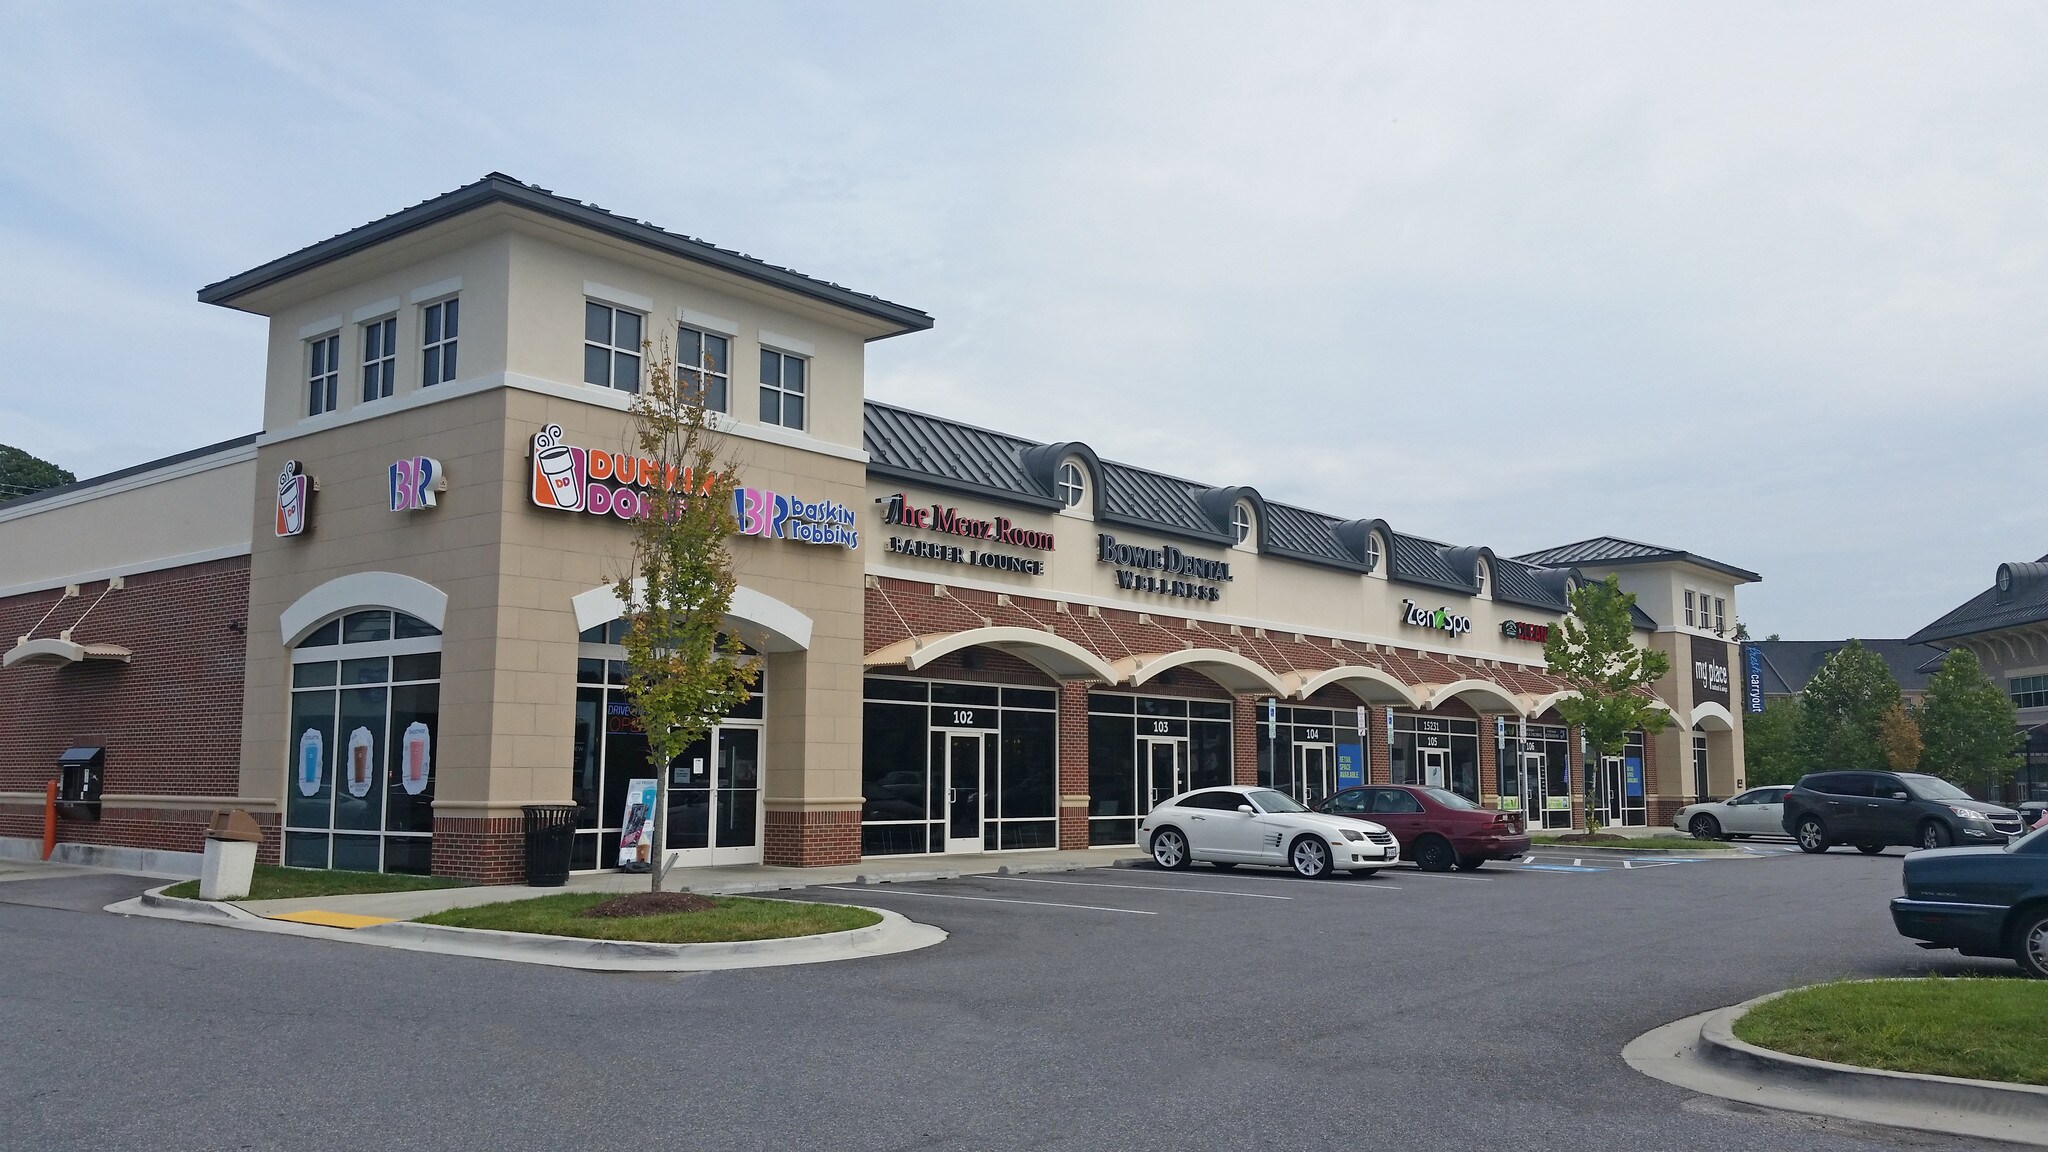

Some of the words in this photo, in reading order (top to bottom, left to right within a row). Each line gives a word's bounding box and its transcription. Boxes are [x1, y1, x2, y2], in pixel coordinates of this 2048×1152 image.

[389, 456, 437, 511] BR
[555, 477, 570, 488] DD
[734, 487, 789, 539] BR
[791, 495, 855, 527] baskin
[876, 493, 931, 529] The
[933, 504, 994, 540] Menz
[995, 517, 1056, 551] Room
[791, 520, 858, 550] robbins
[891, 537, 966, 563] BARBER
[970, 550, 1044, 576] LOUNGE
[1098, 534, 1164, 570] BOWIE
[1163, 545, 1233, 582] DENTAL
[1116, 570, 1219, 601] WELLNESS
[1404, 599, 1435, 627] Zen
[1441, 607, 1472, 638] Spa
[1695, 661, 1708, 689] my
[1708, 658, 1728, 690] place
[1746, 646, 1762, 674] fresh
[1750, 674, 1762, 712] carryout
[609, 716, 641, 732] OPE
[953, 710, 973, 724] 102
[1153, 721, 1169, 733] 103
[1423, 721, 1440, 731] 15231
[1306, 728, 1319, 739] 104
[1427, 737, 1438, 746] 105
[1526, 742, 1535, 751] 106
[1339, 763, 1351, 771] SPACE
[1340, 771, 1359, 779] AVAILABLE
